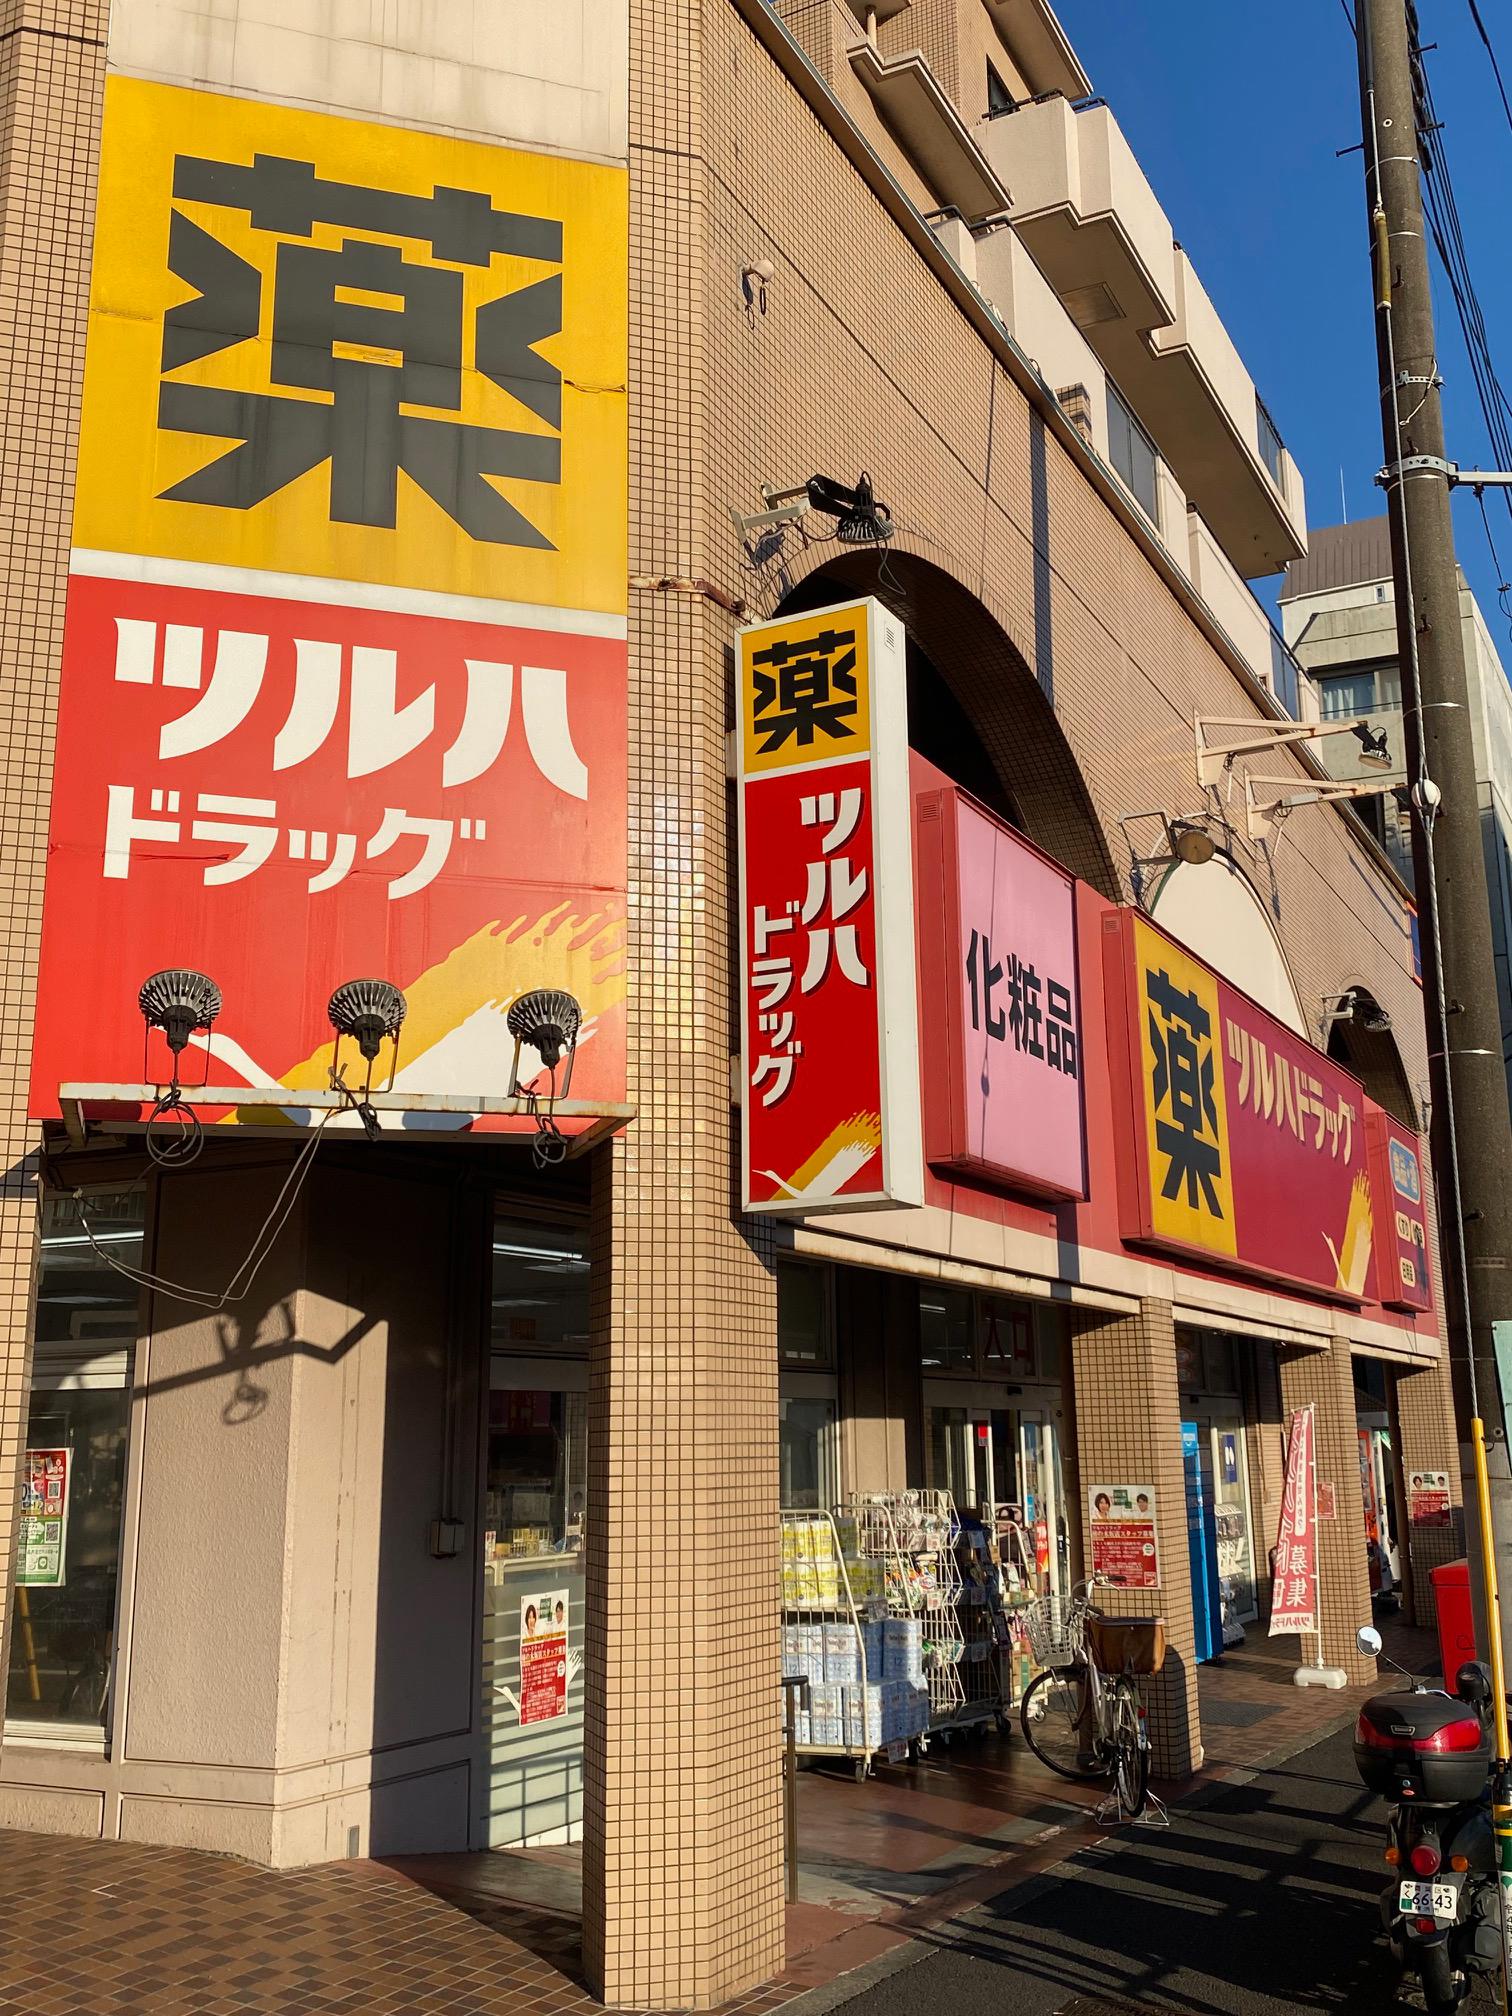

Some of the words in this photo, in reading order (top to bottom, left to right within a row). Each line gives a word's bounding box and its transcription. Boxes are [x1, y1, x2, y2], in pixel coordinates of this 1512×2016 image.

[155, 152, 563, 550] 薬
[113, 618, 588, 801] ツルハ
[752, 629, 857, 756] 薬
[103, 785, 485, 899] ドラッグ
[799, 788, 869, 992] ツルハ
[752, 903, 802, 1108] ドラッグ
[966, 929, 1079, 1079] 化粧品
[1145, 968, 1224, 1219] 薬
[1226, 1018, 1355, 1165] ツルハドラッグ
[1413, 1893, 1452, 1909] 66-43
